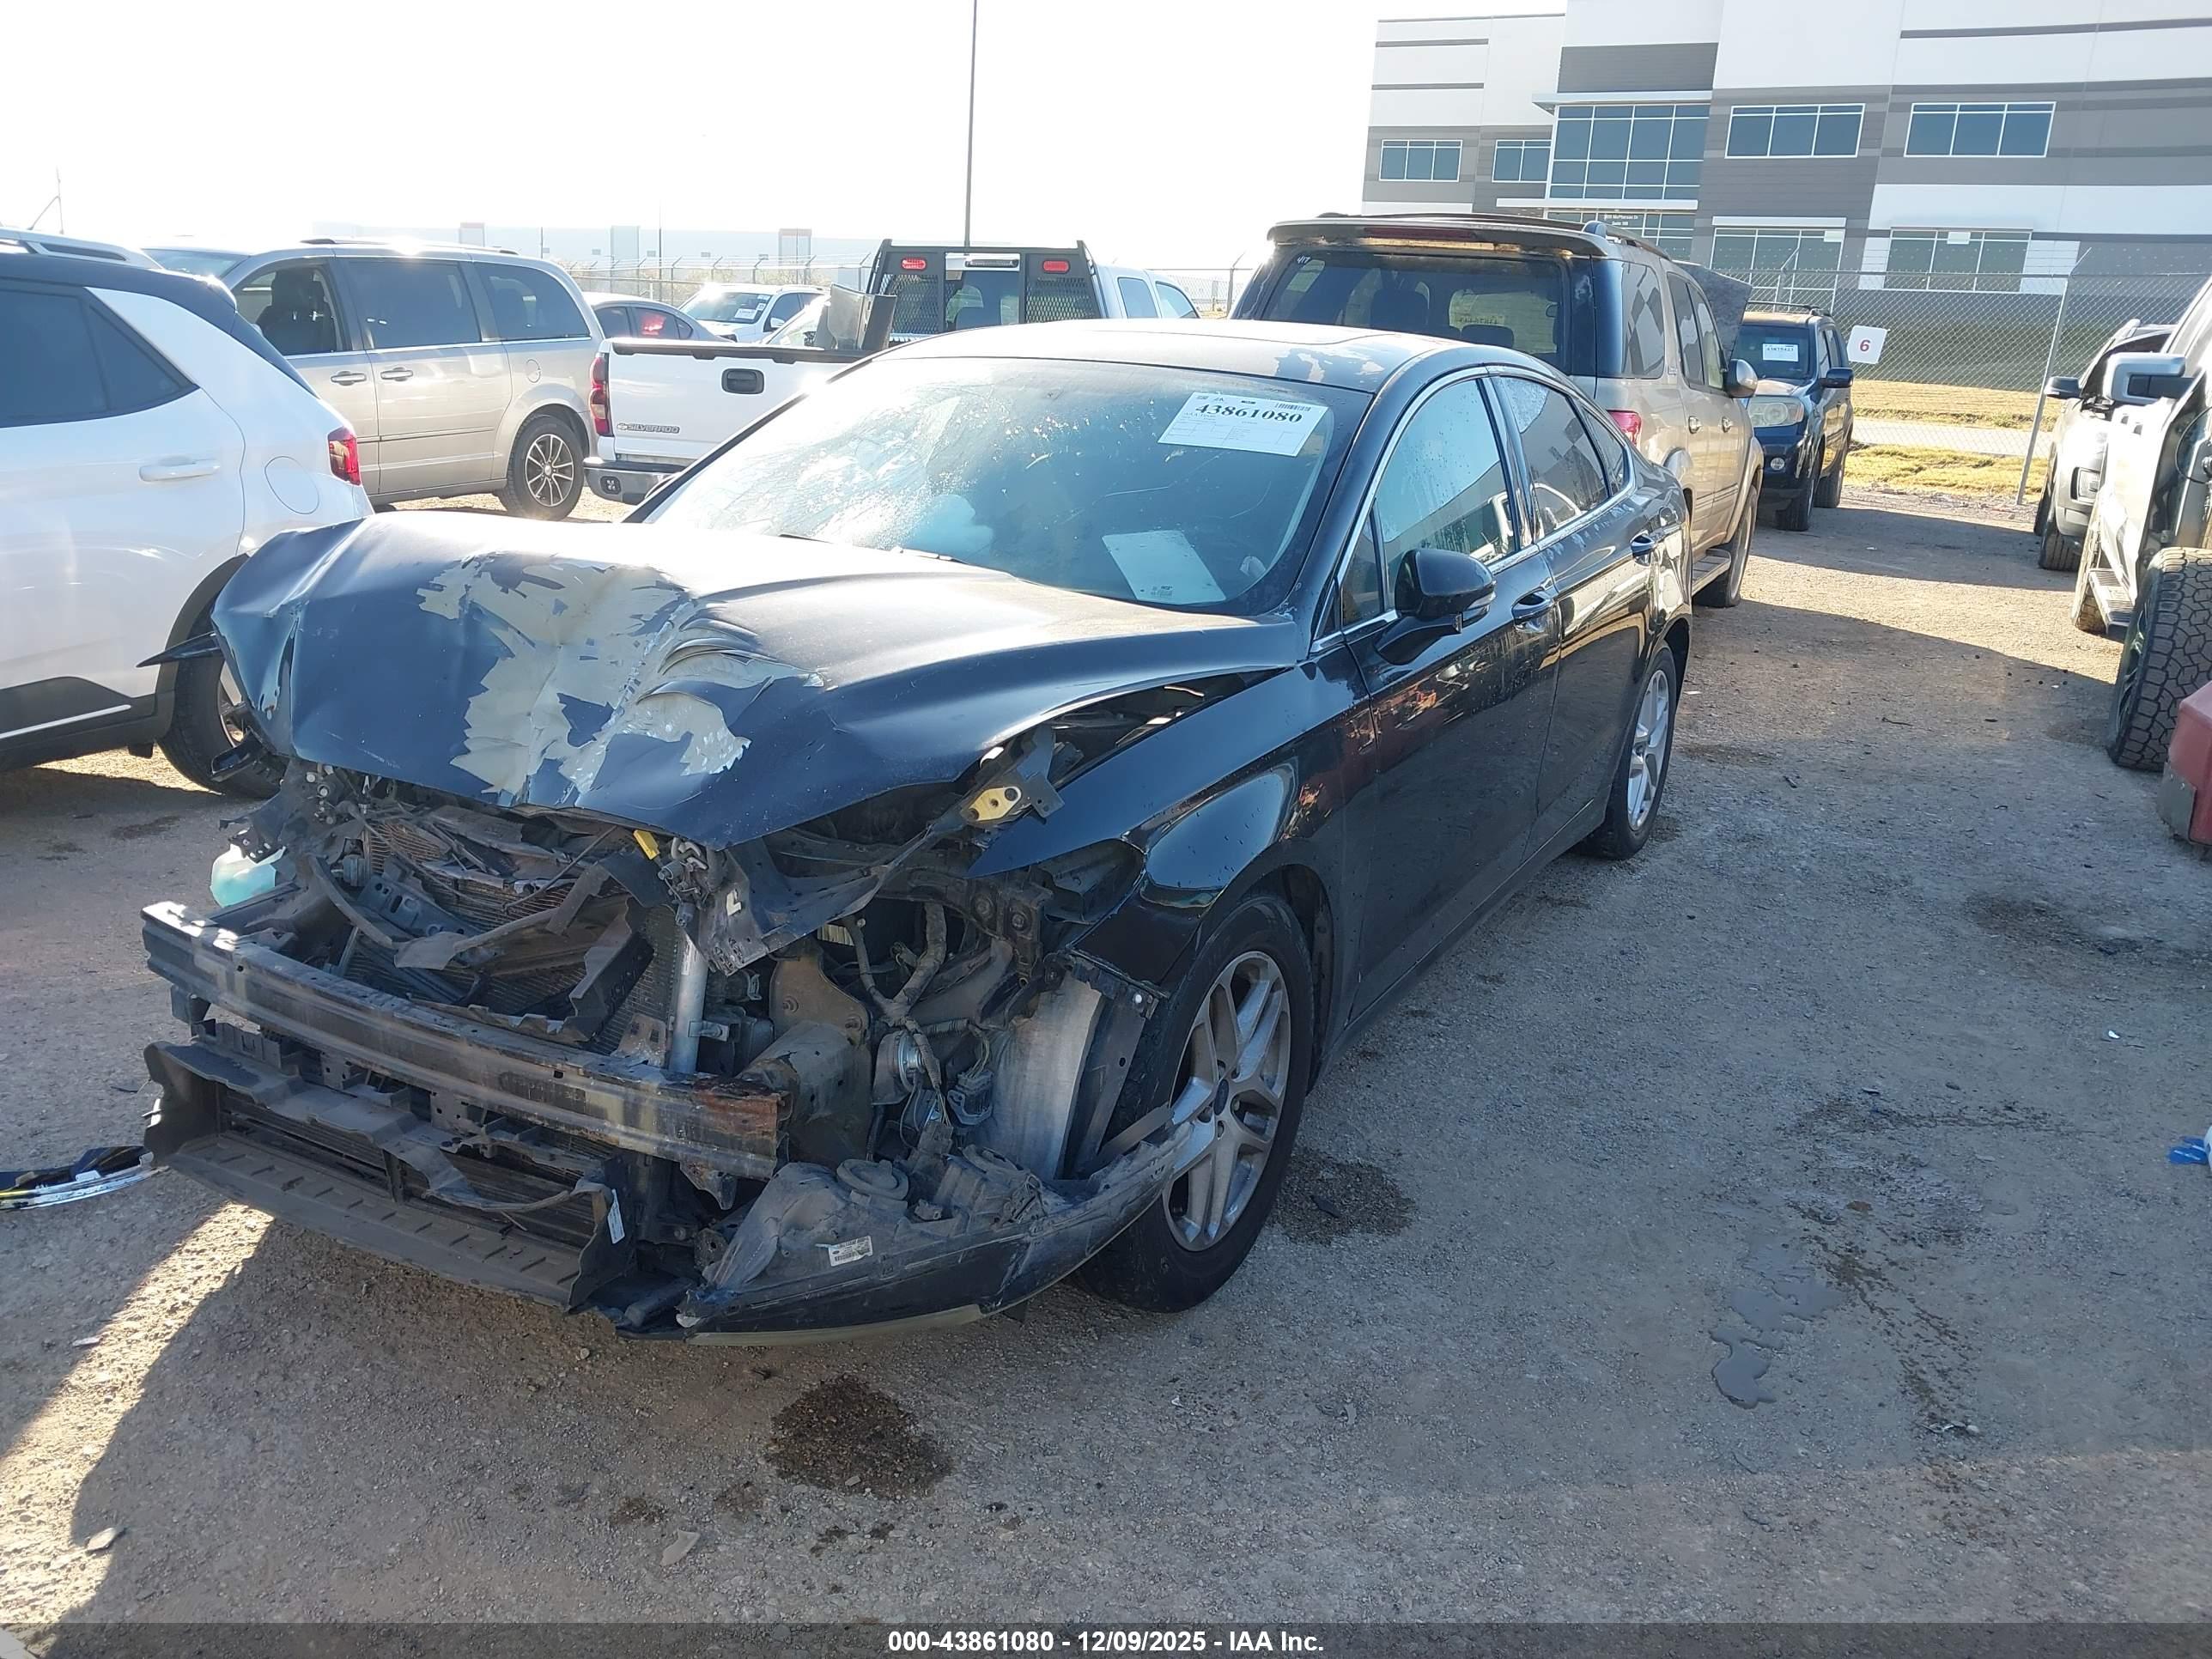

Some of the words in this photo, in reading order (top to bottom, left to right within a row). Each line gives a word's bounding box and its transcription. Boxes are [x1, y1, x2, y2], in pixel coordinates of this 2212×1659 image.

[1860, 339, 1870, 352] 6
[1194, 404, 1303, 423] 43861080
[627, 423, 680, 434] SILVERADO
